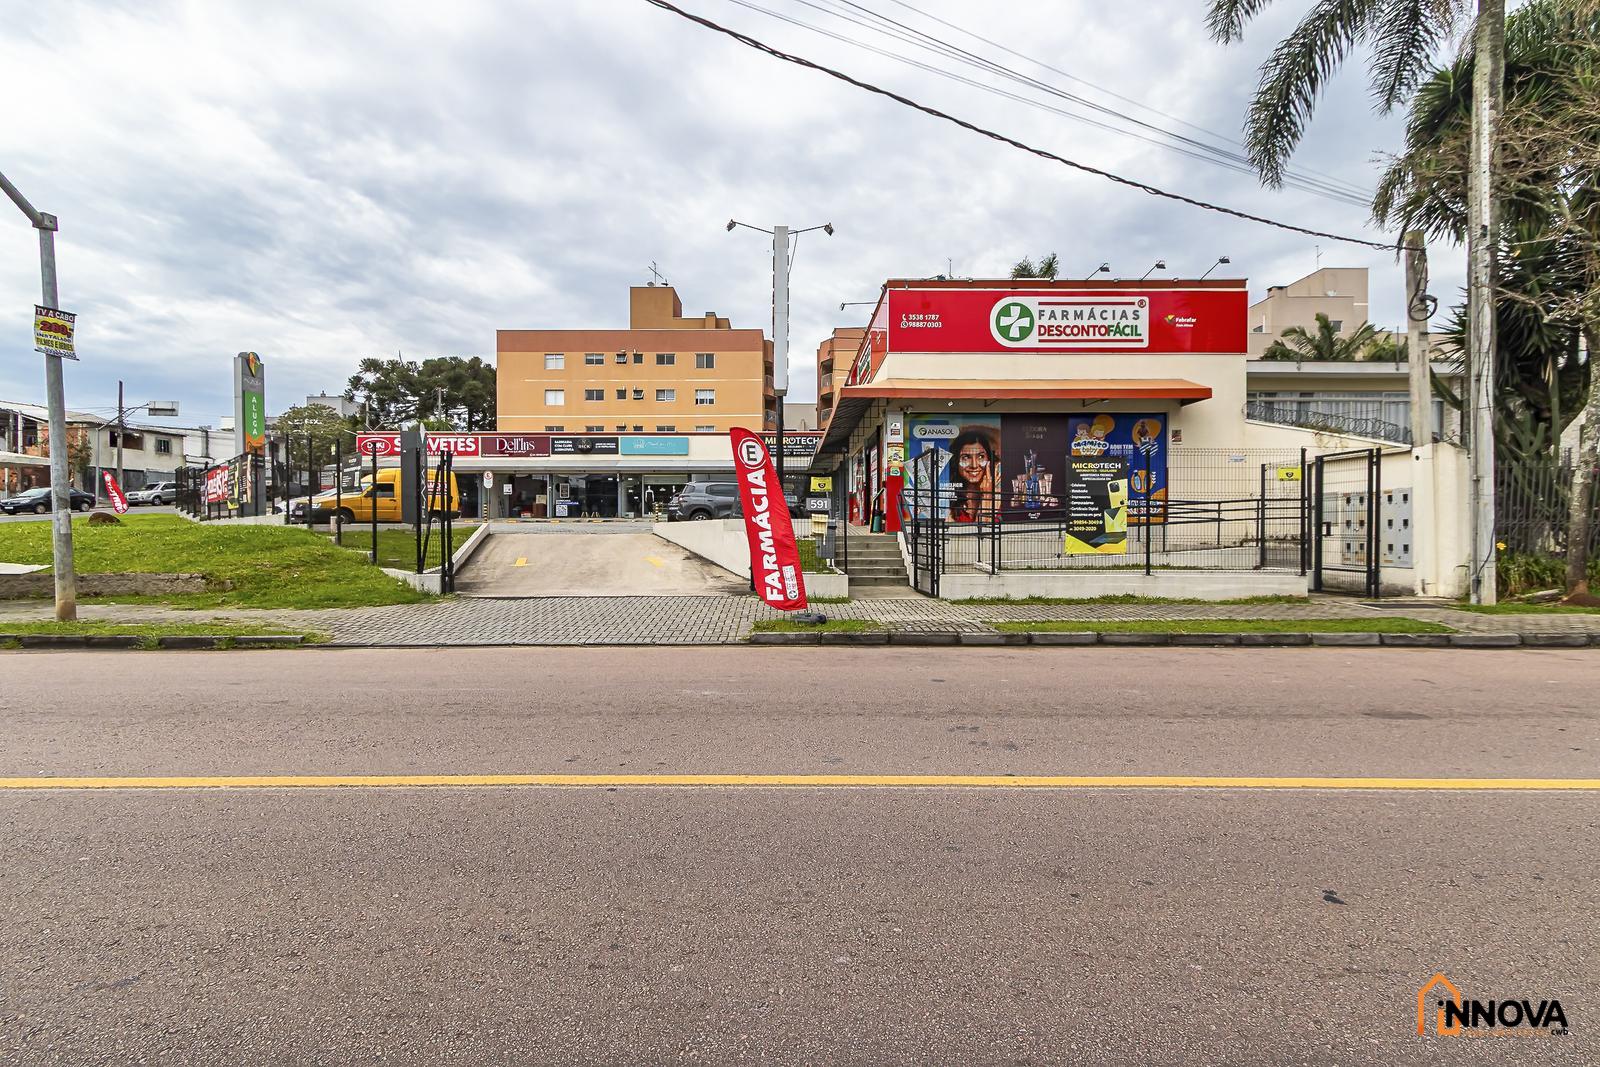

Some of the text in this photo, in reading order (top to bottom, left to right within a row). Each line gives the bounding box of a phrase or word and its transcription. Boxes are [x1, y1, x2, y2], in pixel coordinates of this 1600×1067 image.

[36, 307, 74, 322] TV A CABO
[1038, 307, 1140, 321] FARMÁCIAS
[1038, 322, 1142, 337] DESCONTOFÁCIL
[764, 436, 820, 445] MIROTECH
[810, 500, 828, 509] 591
[747, 469, 785, 600] FARMÁCIA
